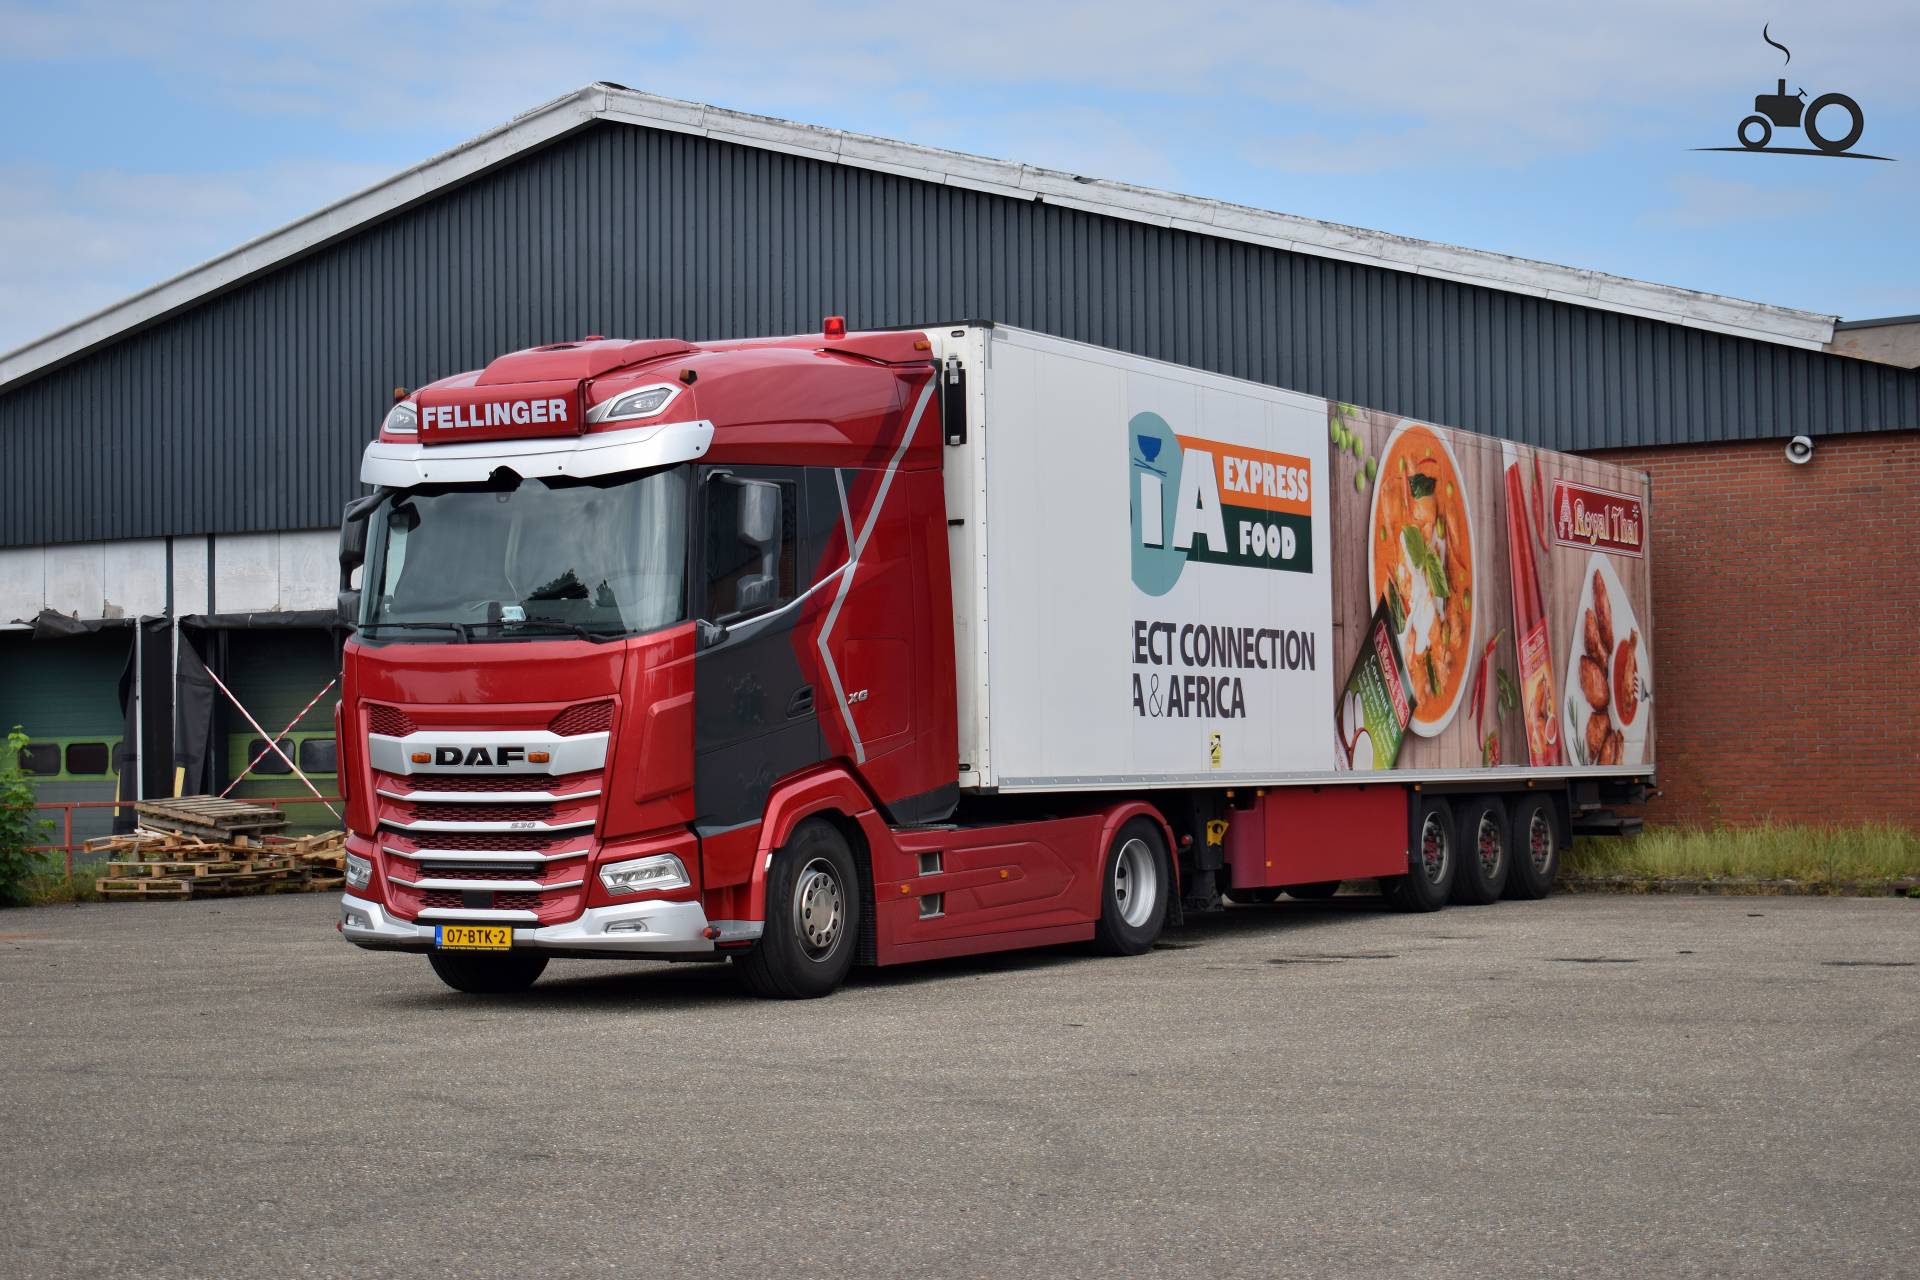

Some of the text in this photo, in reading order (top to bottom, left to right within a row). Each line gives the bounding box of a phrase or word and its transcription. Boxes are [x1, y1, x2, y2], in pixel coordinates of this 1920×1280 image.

[422, 398, 568, 430] FELLINGER
[1222, 455, 1309, 503] EXPRESS
[1238, 520, 1297, 560] FOOD
[1573, 498, 1640, 546] Royal Thai
[1131, 620, 1316, 672] ECT CONNECTION
[1148, 673, 1164, 718] &
[1166, 674, 1247, 719] AFRICA
[435, 747, 525, 767] DAF
[446, 928, 507, 945] 07-BTK-2
